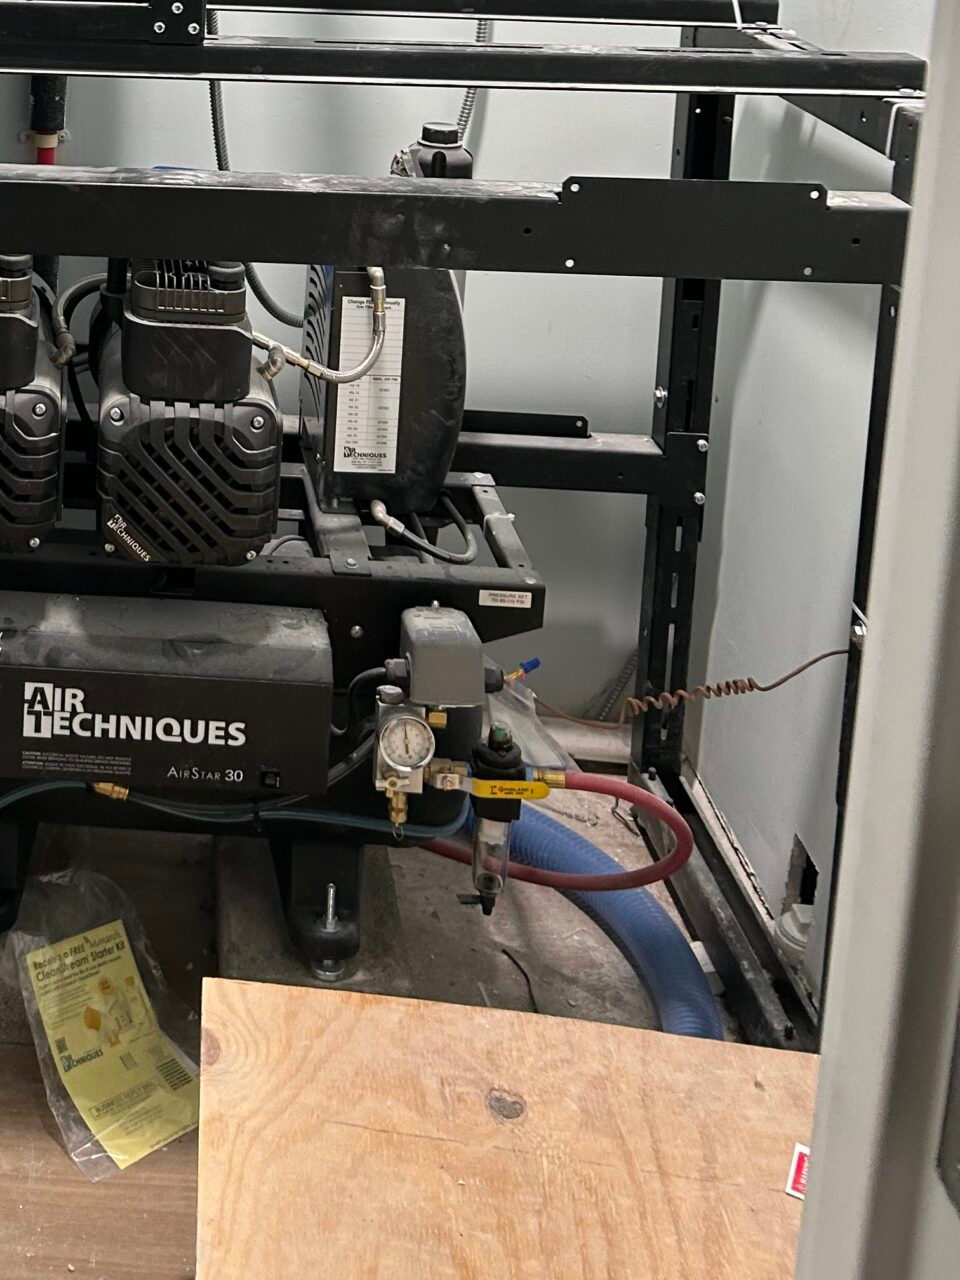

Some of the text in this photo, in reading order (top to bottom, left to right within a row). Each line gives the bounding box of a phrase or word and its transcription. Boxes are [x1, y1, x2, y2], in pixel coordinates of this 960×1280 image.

[107, 520, 152, 562] TECHNIQUES
[24, 682, 85, 713] AIR
[23, 706, 246, 746] TECHNIQUES
[224, 769, 244, 782] 30
[90, 945, 115, 962] Starter
